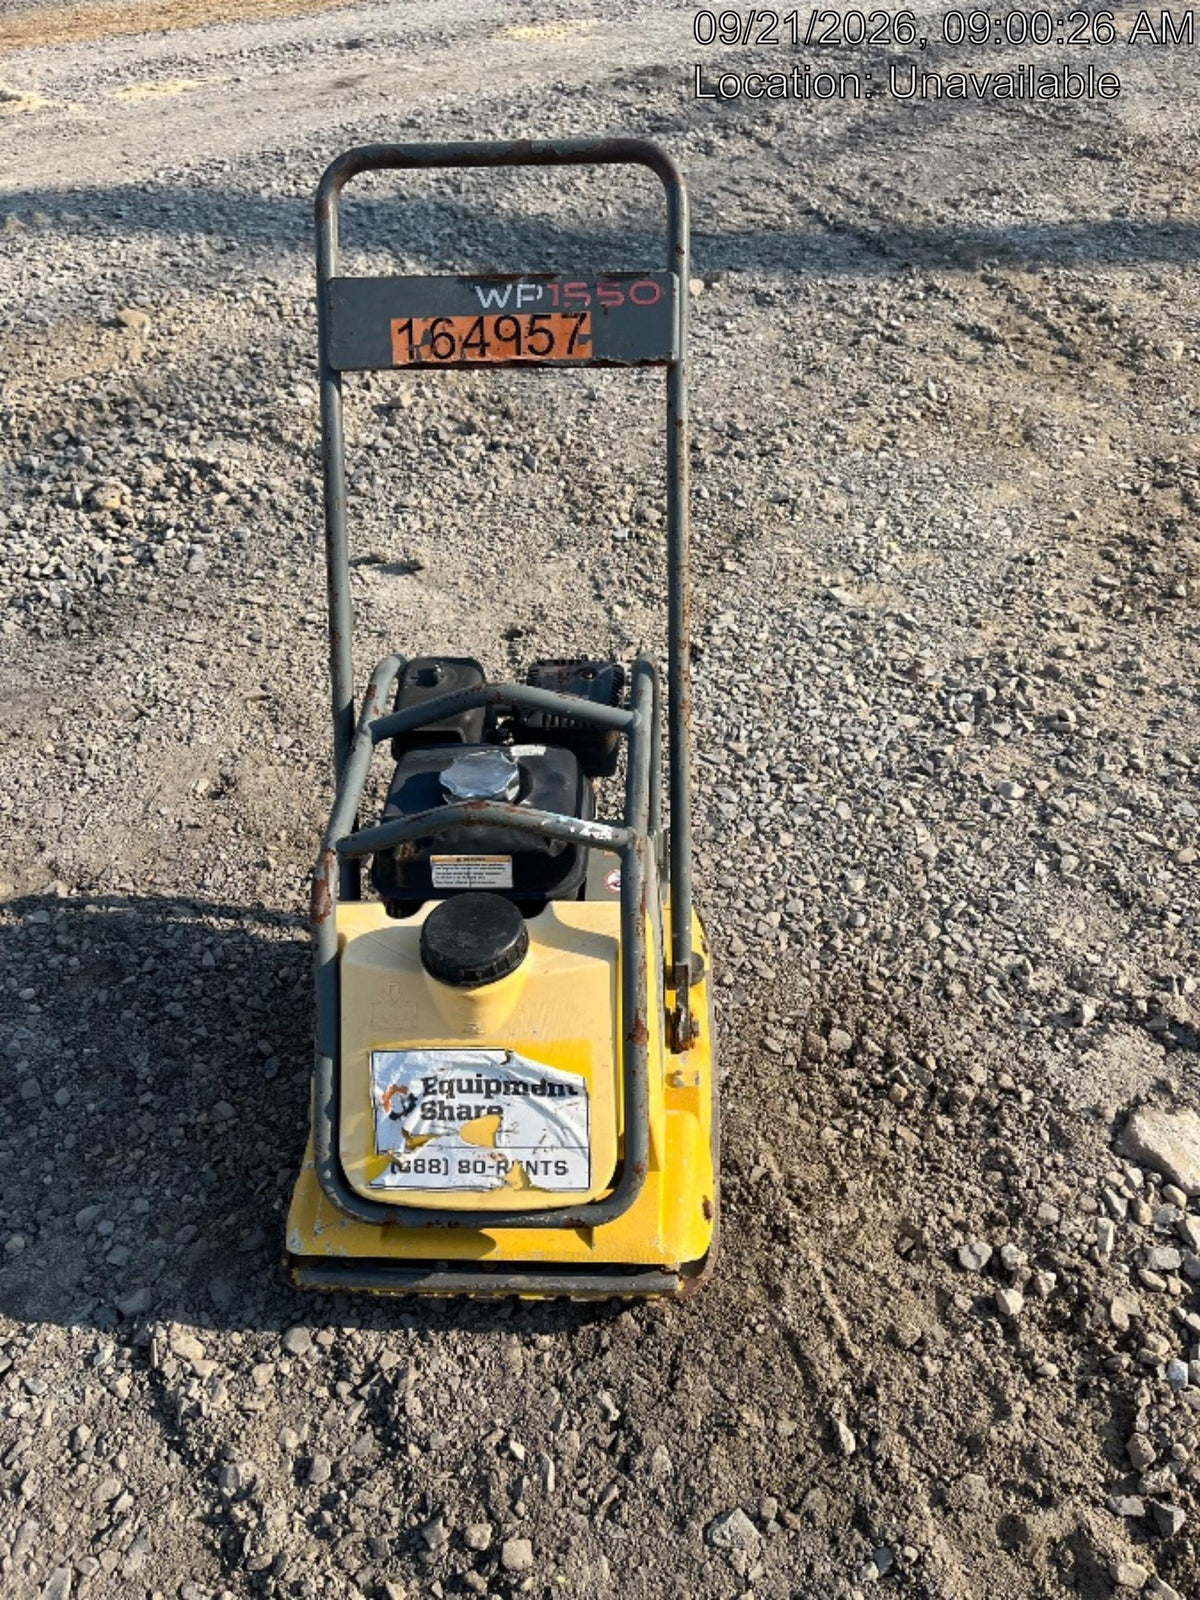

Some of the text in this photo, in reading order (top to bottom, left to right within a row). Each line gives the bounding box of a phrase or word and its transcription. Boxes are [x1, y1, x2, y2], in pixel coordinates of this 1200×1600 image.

[474, 281, 662, 308] WP1550
[396, 312, 588, 360] 164957
[457, 1160, 569, 1176] 80-RNTS
